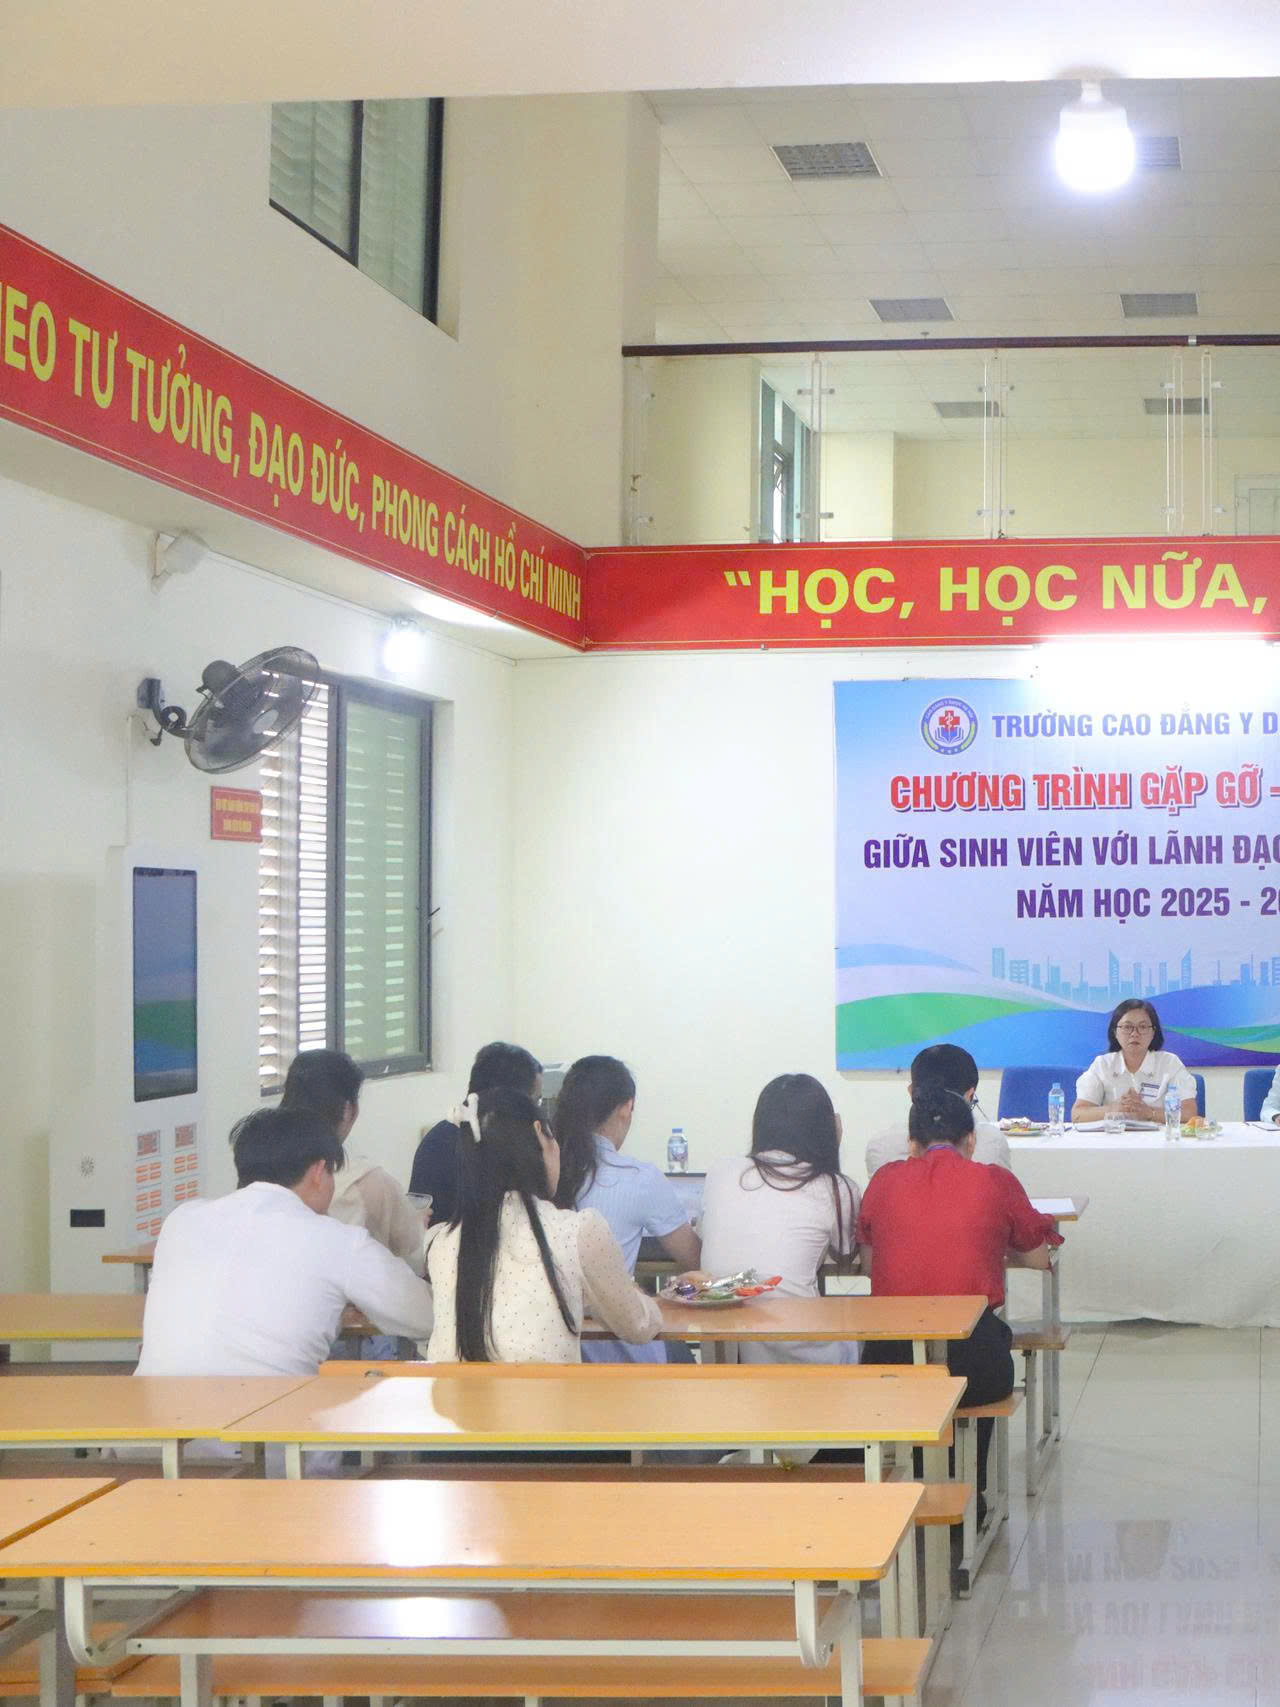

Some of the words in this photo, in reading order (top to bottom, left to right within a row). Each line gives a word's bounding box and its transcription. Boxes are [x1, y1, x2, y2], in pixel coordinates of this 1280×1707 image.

[0, 282, 56, 382] EO
[67, 318, 120, 410] TƯ
[125, 344, 240, 478] TƯỞNG,
[248, 411, 304, 507] ĐẠO
[310, 438, 364, 532] ĐỨC,
[372, 475, 439, 557] PHONG
[443, 505, 490, 581] CÁCH
[494, 521, 517, 592] HỒ
[520, 545, 545, 604] CHÍ
[546, 562, 581, 621] MINH
[939, 564, 1078, 626] HỌC
[1102, 550, 1267, 614] NỮA,
[991, 709, 1094, 738] TRƯỜNG
[1102, 713, 1151, 737] CAO
[1239, 712, 1254, 735] Y
[890, 771, 1025, 812] CHƯƠNG
[1033, 766, 1132, 811] TRÌNH
[1140, 765, 1208, 816] GẶP
[1216, 763, 1264, 808] GỠ
[863, 833, 930, 869] GIỮA
[940, 837, 1008, 868] SINH
[1017, 831, 1083, 867] VIÊN
[1092, 830, 1138, 866] VỚI
[1149, 829, 1223, 865] LÃNH
[1017, 882, 1083, 919] NĂM
[1094, 887, 1151, 924] HỌC
[1160, 887, 1230, 917] 2025
